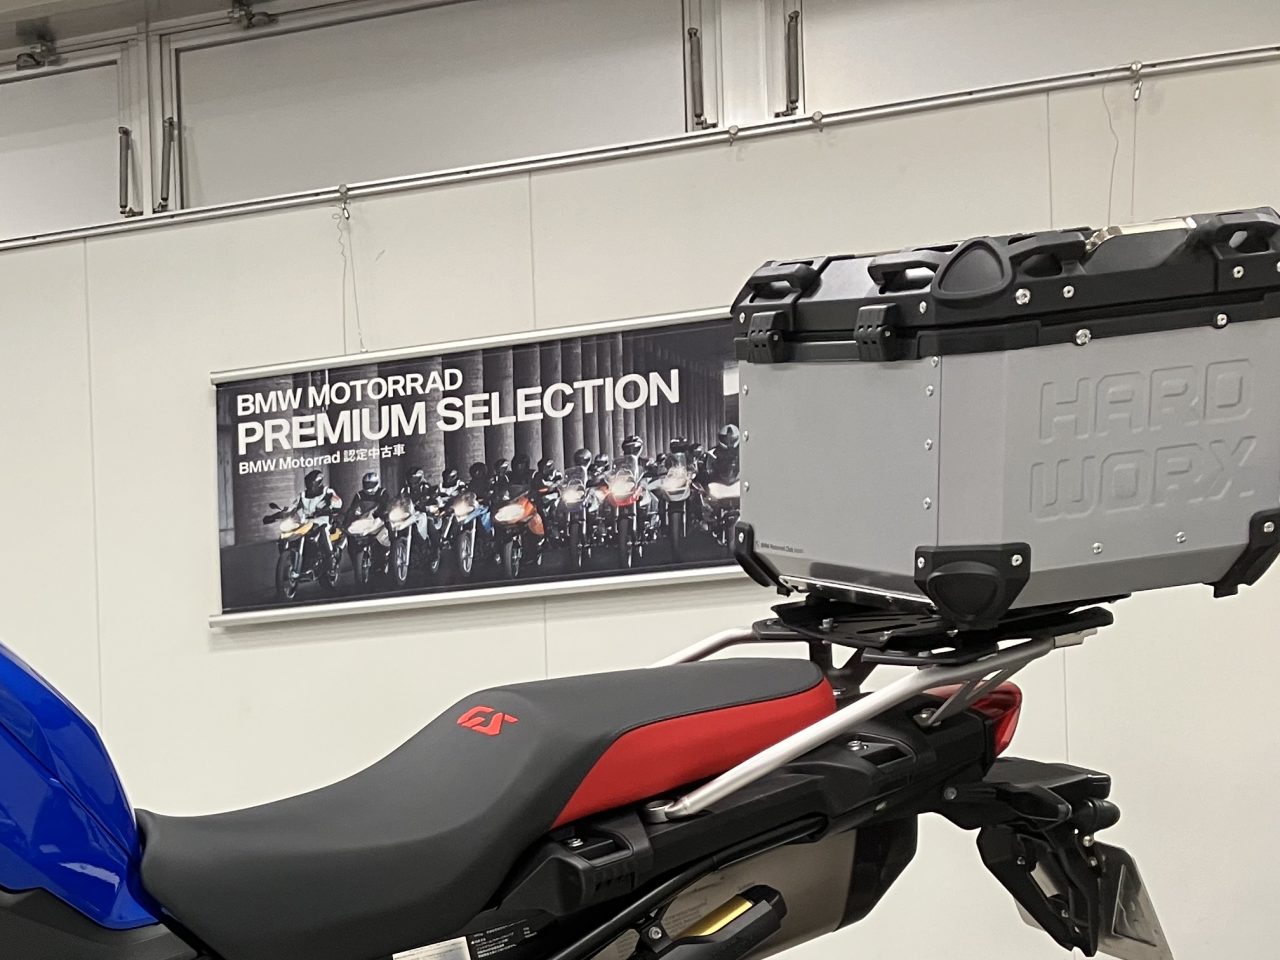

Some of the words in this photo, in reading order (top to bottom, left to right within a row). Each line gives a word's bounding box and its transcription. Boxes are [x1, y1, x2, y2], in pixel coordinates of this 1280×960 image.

[236, 387, 303, 416] BMW
[308, 368, 463, 409] MOTORRAD
[237, 401, 427, 456] PREMIUM
[436, 368, 680, 432] SELECTION
[1039, 358, 1253, 445] HARD
[238, 458, 276, 475] BMW
[278, 451, 341, 471] Motorrad
[343, 443, 406, 463] 認定中古車
